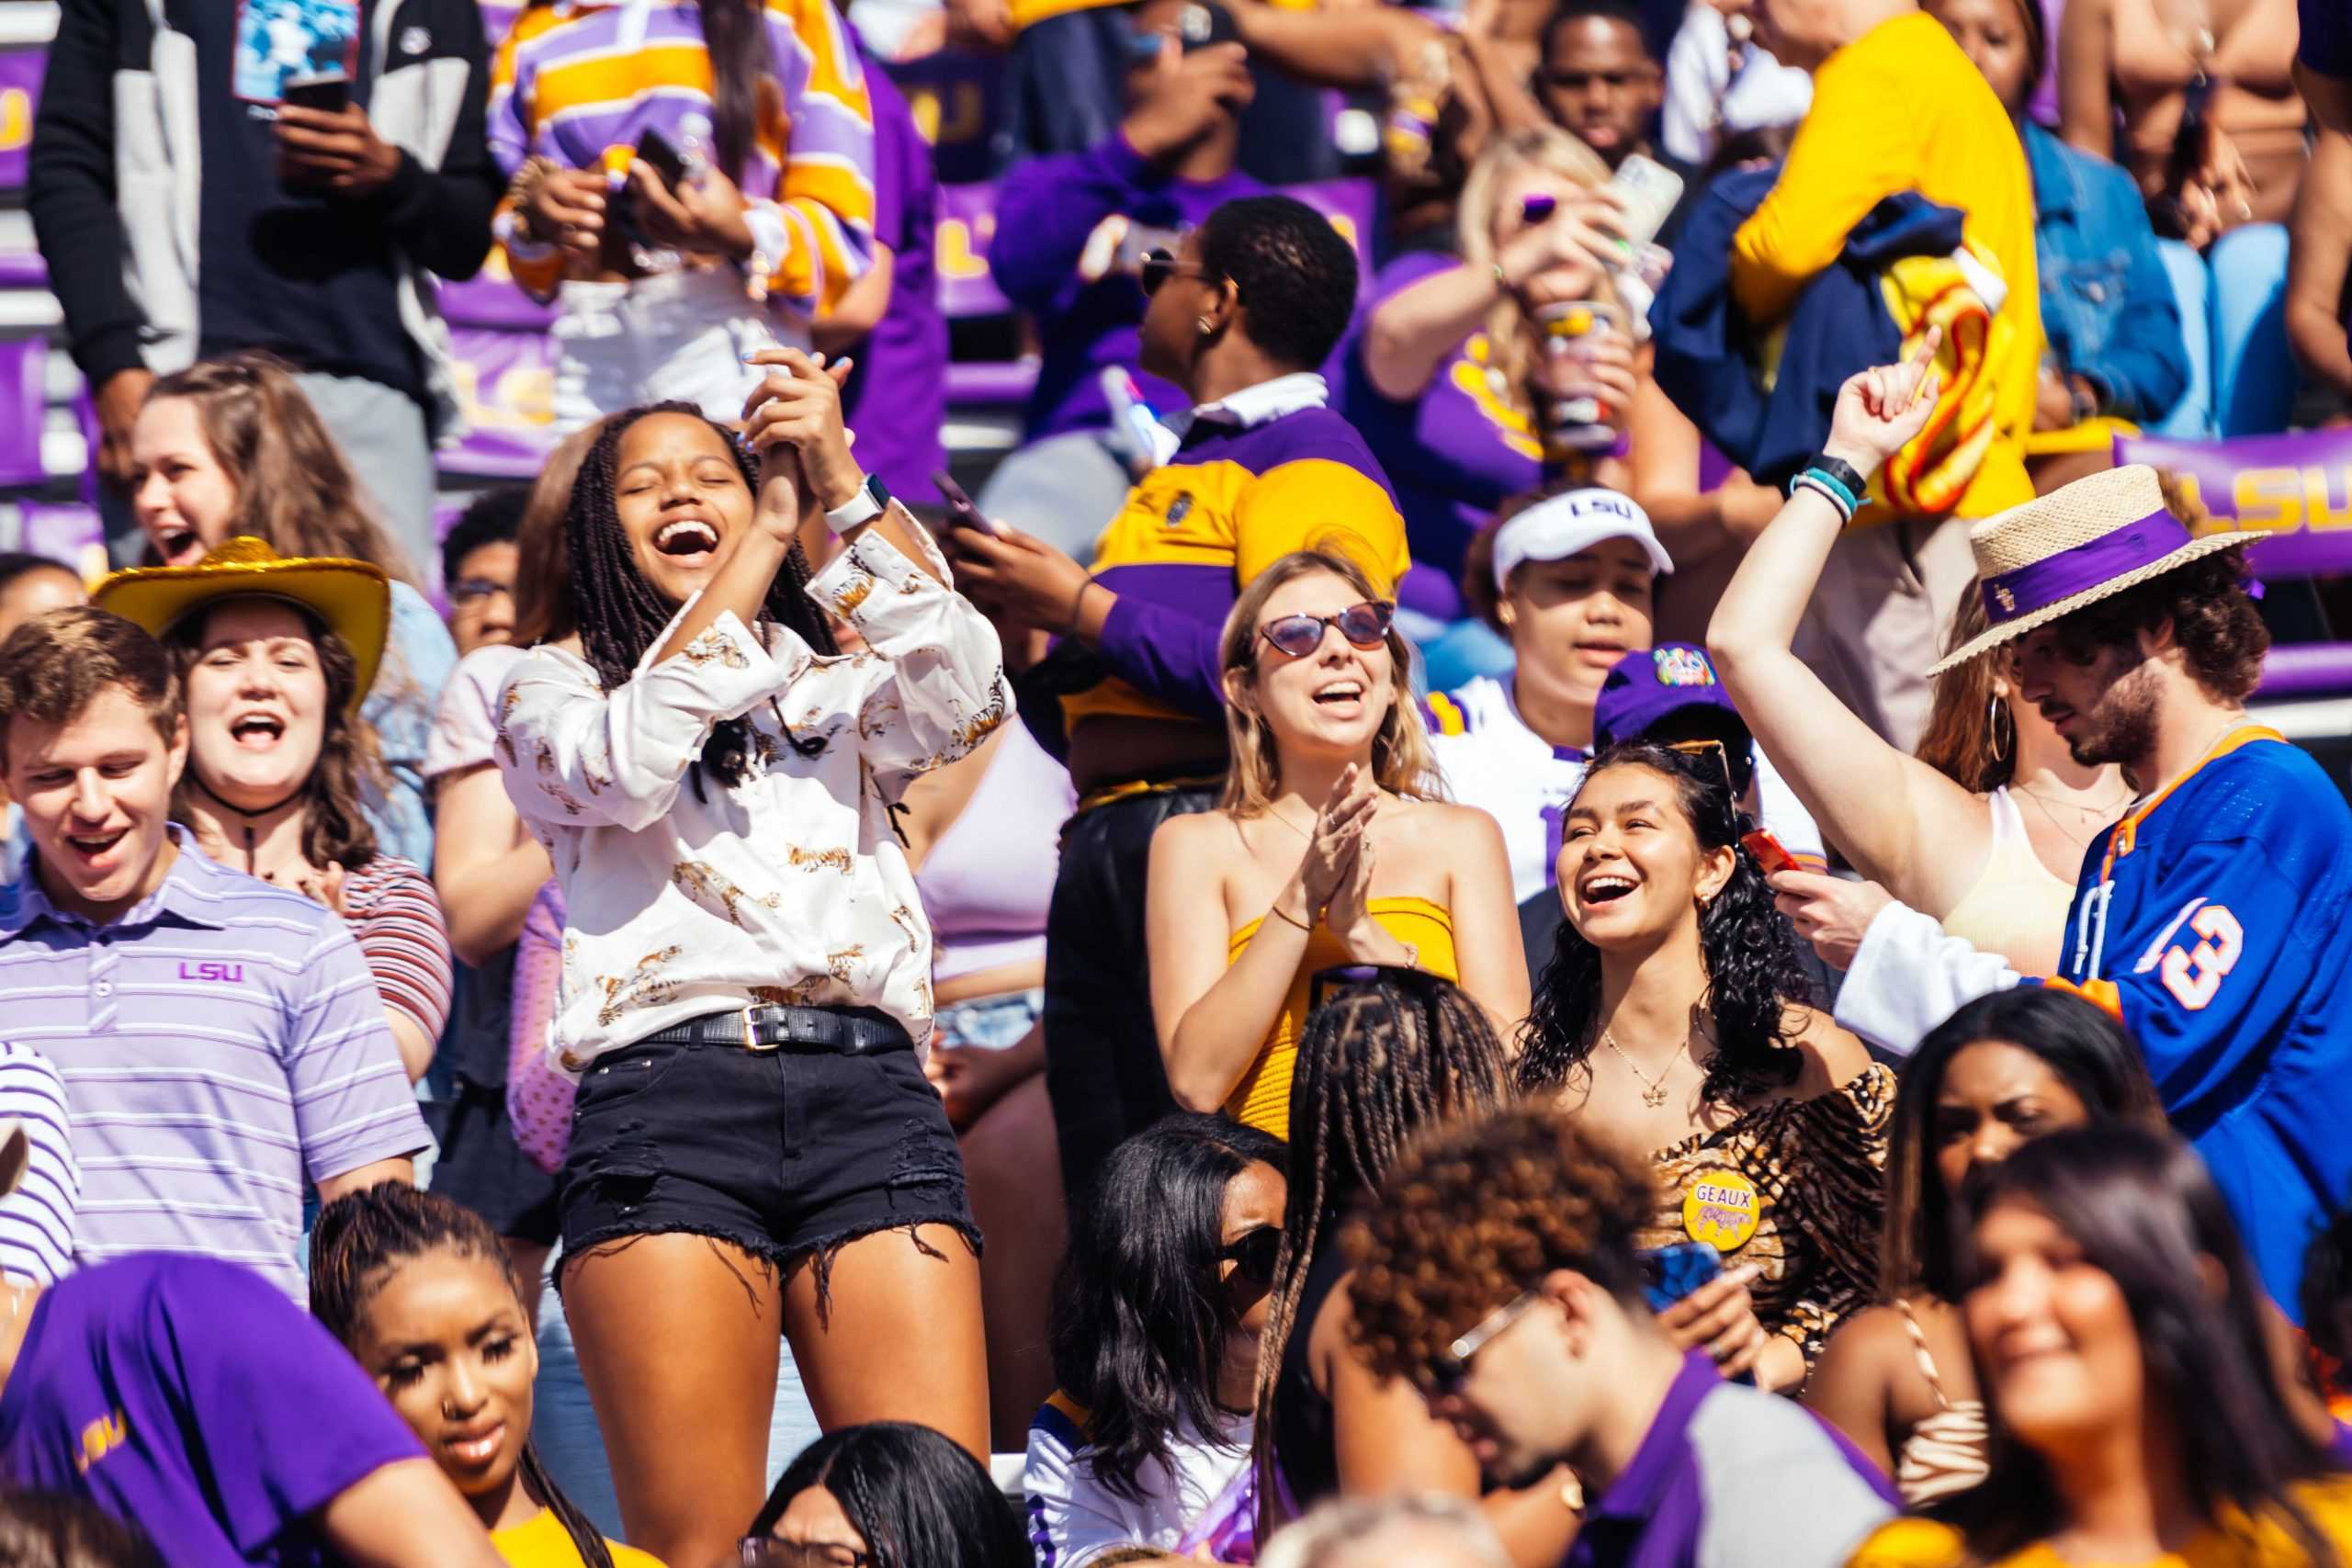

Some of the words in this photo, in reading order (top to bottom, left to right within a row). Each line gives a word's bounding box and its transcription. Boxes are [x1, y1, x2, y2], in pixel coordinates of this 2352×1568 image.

[1570, 500, 1632, 520] LSU
[2132, 897, 2244, 1010] 13
[179, 962, 243, 983] LSU
[1696, 1185, 1751, 1208] GEAUX
